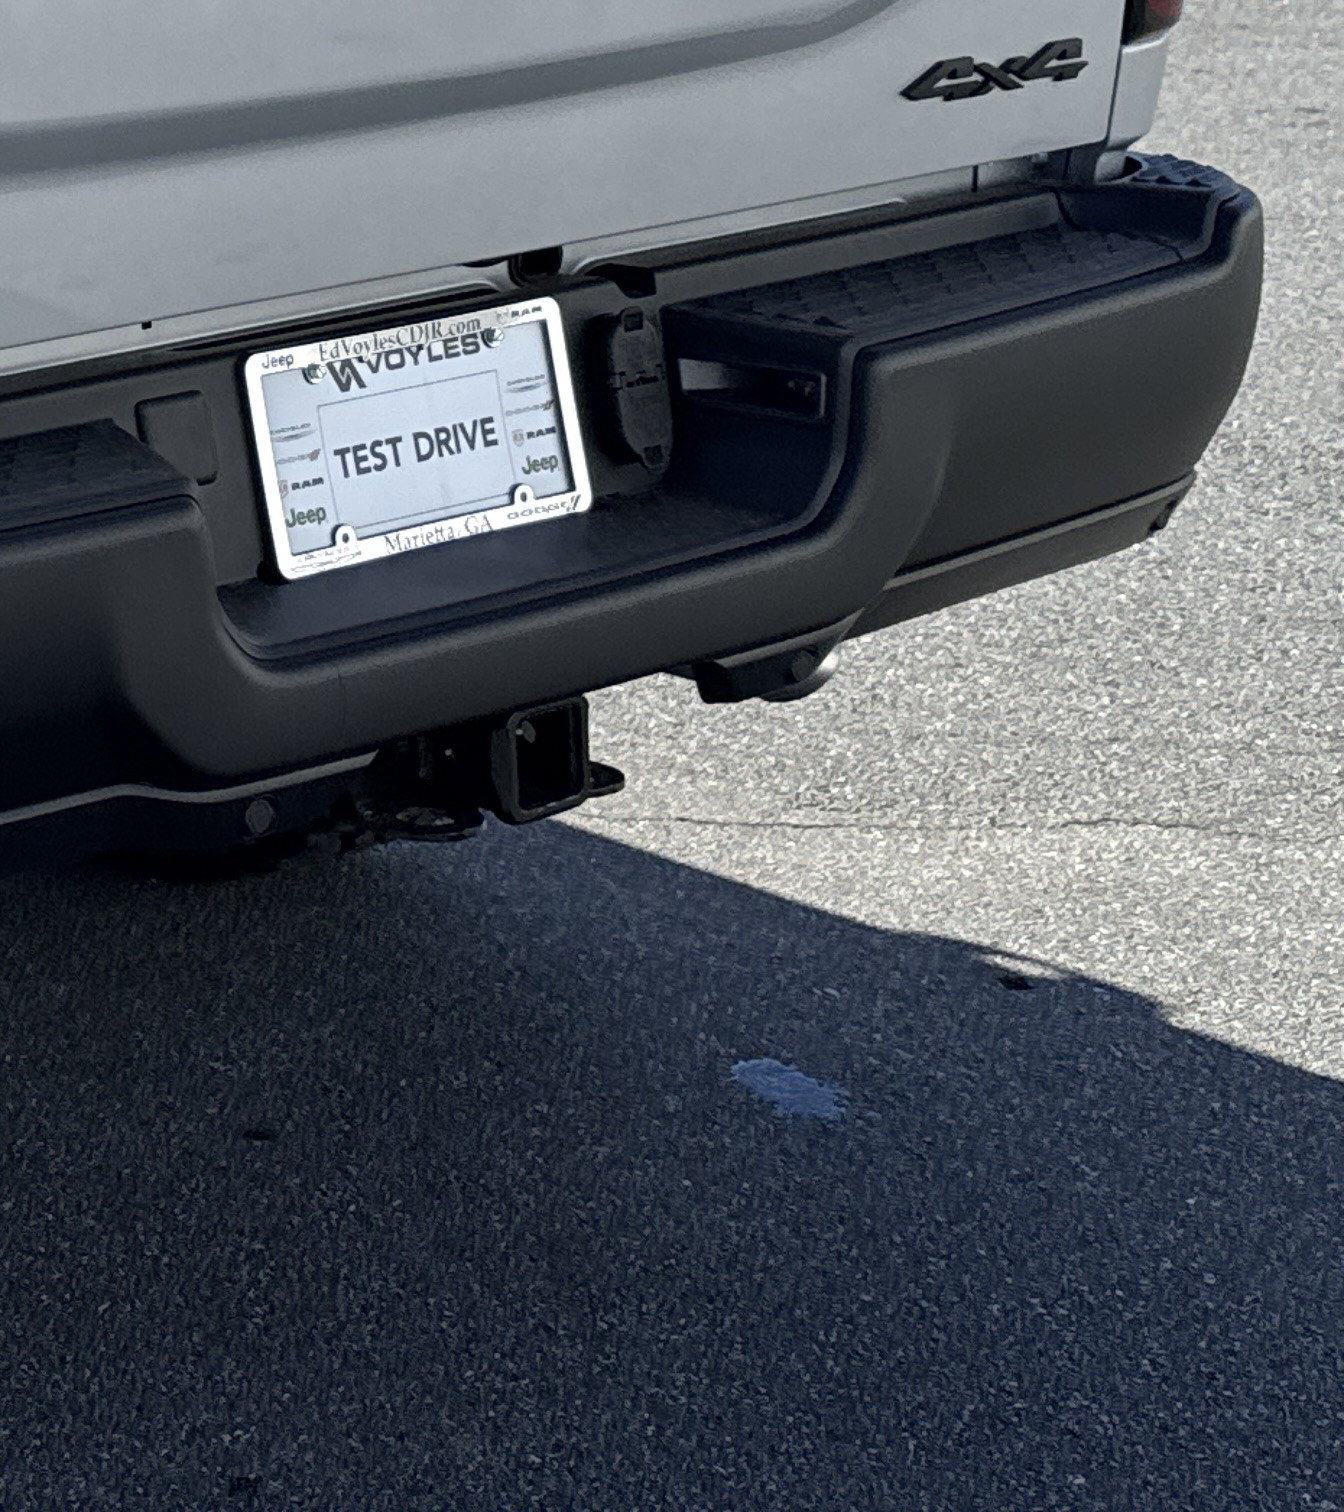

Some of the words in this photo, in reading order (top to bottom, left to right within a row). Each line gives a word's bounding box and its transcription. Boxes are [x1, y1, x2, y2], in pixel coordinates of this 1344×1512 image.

[318, 316, 482, 362] EdVoylesCDJR.com
[262, 353, 295, 370] Jeep
[525, 425, 558, 440] RAM
[333, 435, 404, 479] TEST
[412, 416, 500, 463] DRIVE
[521, 454, 559, 475] Jeep
[291, 476, 325, 491] RAM
[285, 506, 327, 528] Jeep
[463, 513, 495, 537] GA
